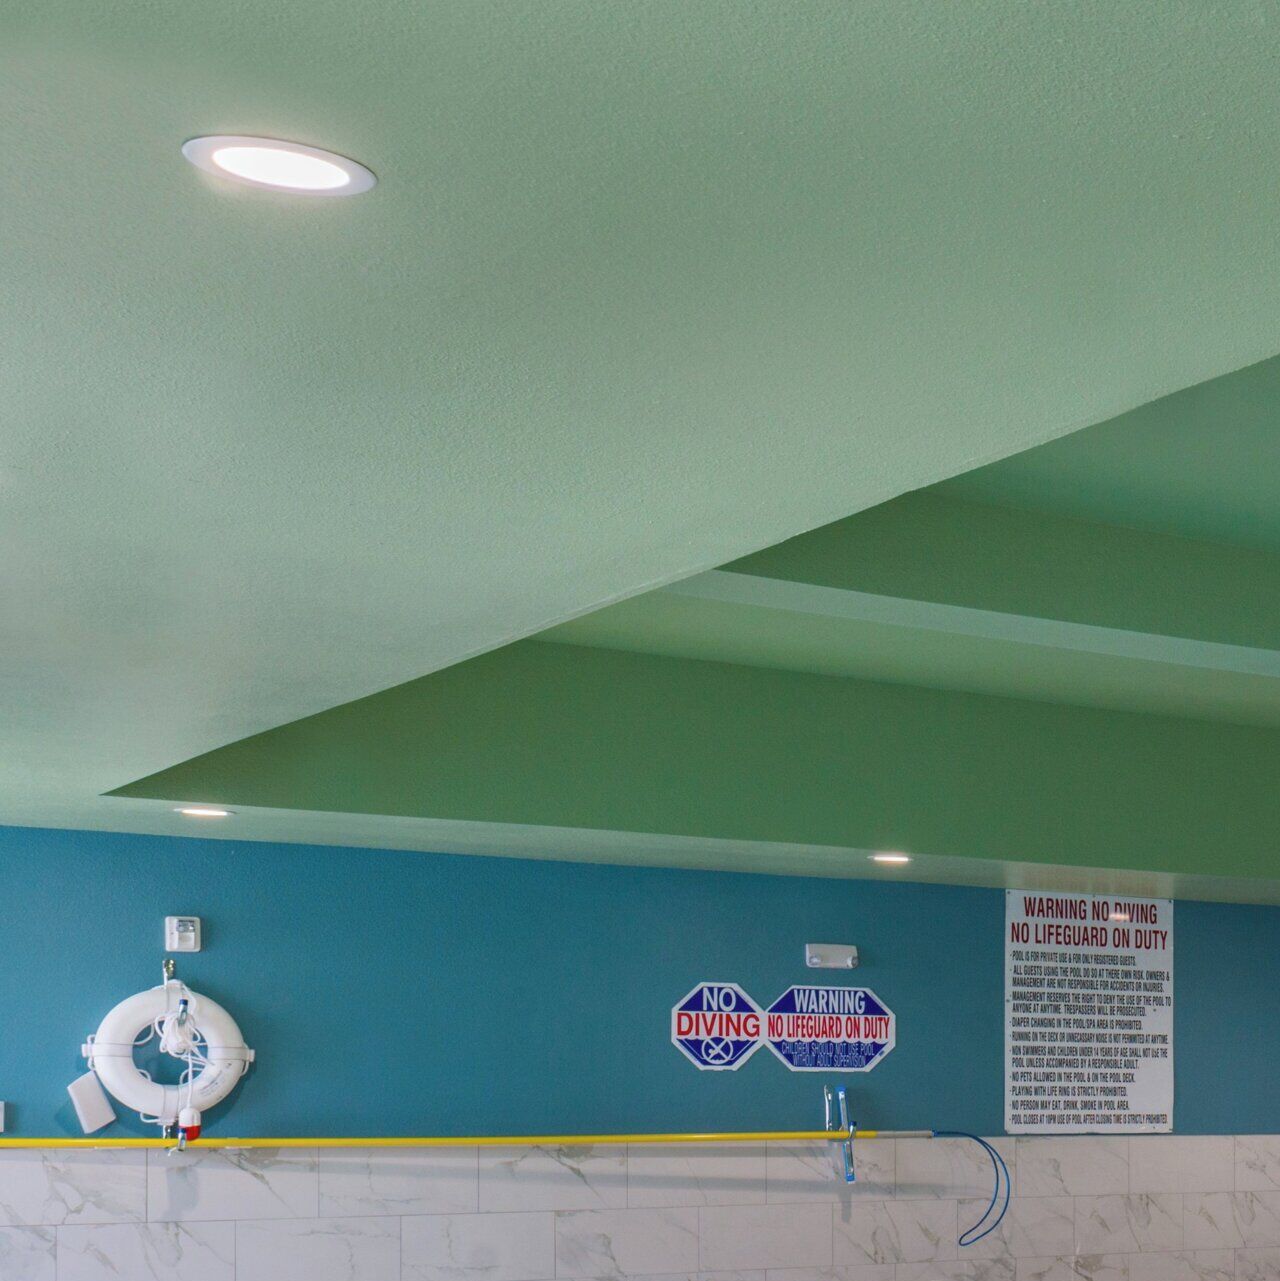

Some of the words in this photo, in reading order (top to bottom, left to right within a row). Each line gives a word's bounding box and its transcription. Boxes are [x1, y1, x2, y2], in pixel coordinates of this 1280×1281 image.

[1024, 896, 1087, 920] WARNING
[1092, 901, 1109, 921] NO
[1114, 902, 1157, 924] DIVING
[1011, 922, 1029, 943] NO
[1035, 923, 1108, 947] LIFEGUARD
[1113, 928, 1129, 948] ON
[1135, 929, 1167, 950] DUTY
[1012, 950, 1024, 961] POOL
[1025, 951, 1030, 961] IS
[1031, 951, 1039, 962] FOR
[1040, 951, 1058, 962] PRIVATE
[1059, 952, 1068, 963] USE
[1069, 953, 1072, 963] &
[1073, 953, 1082, 964] FOR
[1082, 954, 1093, 964] ONLY
[1120, 956, 1136, 966] GUESTS.
[1013, 965, 1022, 975] ALL
[1023, 965, 1042, 976] GUESTS
[1043, 966, 1058, 977] USING
[1060, 967, 1068, 977] THE
[1070, 967, 1082, 978] POOL
[1083, 968, 1089, 978] DO
[1091, 968, 1097, 978] SO
[1099, 968, 1105, 979] AT
[1106, 969, 1120, 979] THERE
[1121, 969, 1132, 980] OWN
[1133, 970, 1144, 980] RISK.
[1146, 970, 1165, 981] OWNERS
[1166, 971, 1170, 981] &
[1047, 978, 1056, 988] ARE
[1057, 978, 1066, 988] NOT
[1100, 980, 1109, 990] FOR
[1110, 980, 1135, 991] ACCIDENTS
[1136, 981, 1142, 991] OR
[1143, 981, 1164, 992] INJURIES.
[702, 987, 736, 1012] NO
[794, 989, 865, 1014] WARNING
[1047, 992, 1070, 1003] RESERVES
[1072, 993, 1080, 1003] THE
[1082, 993, 1095, 1004] RIGHT
[1097, 994, 1102, 1004] TO
[1103, 994, 1115, 1005] DENY
[1116, 994, 1125, 1005] THE
[1126, 995, 1135, 1005] USE
[1136, 995, 1142, 1005] OF
[1143, 995, 1151, 1006] THE
[1153, 996, 1164, 1006] POOL
[1165, 996, 1171, 1007] TO
[1012, 1003, 1032, 1013] ANYONE
[1033, 1004, 1039, 1014] AT
[1097, 1005, 1108, 1016] WILL
[1110, 1006, 1116, 1016] BE
[676, 1012, 760, 1037] DIVING
[768, 1015, 783, 1037] NO
[787, 1015, 842, 1039] LIFEGUARD
[846, 1016, 861, 1039] ON
[864, 1017, 890, 1039] DUTY
[1012, 1017, 1030, 1027] DIAPER
[1031, 1017, 1055, 1028] CHANGING
[1056, 1018, 1061, 1028] IN
[1063, 1018, 1072, 1028] THE
[1097, 1019, 1108, 1029] AREA
[1110, 1019, 1114, 1029] IS
[1012, 1031, 1031, 1042] RUNNING
[1032, 1031, 1038, 1042] ON
[1039, 1032, 1047, 1042] THE
[1048, 1032, 1059, 1042] DECK
[1060, 1032, 1065, 1042] OR
[1096, 1033, 1107, 1043] NOISE
[1108, 1033, 1112, 1043] IS
[1113, 1033, 1121, 1043] NOT
[1145, 1034, 1151, 1044] AT
[782, 1042, 810, 1054] CHILDREN
[811, 1042, 834, 1056] SHOULD
[835, 1043, 847, 1055] NOT
[848, 1043, 859, 1055] USE
[860, 1043, 875, 1056] POOL
[1012, 1045, 1021, 1056] NON
[1022, 1045, 1047, 1056] SWIMMERS
[1048, 1046, 1056, 1056] AND
[1057, 1046, 1078, 1056] CHILDREN
[1079, 1046, 1093, 1056] UNDER
[1094, 1047, 1099, 1057] 14
[1100, 1047, 1113, 1057] YEARS
[1114, 1047, 1119, 1057] OF
[1120, 1047, 1128, 1057] AGE
[1129, 1047, 1141, 1057] SHALL
[1143, 1048, 1151, 1057] NOT
[1151, 1048, 1159, 1057] USE
[1160, 1048, 1168, 1057] THE
[793, 1054, 816, 1066] WITHOUT
[817, 1054, 833, 1067] ADULT
[834, 1055, 866, 1067] SUPERVISION
[1012, 1057, 1024, 1068] POOL
[1026, 1057, 1046, 1068] UNLESS
[1124, 1059, 1139, 1069] ADULT.
[1020, 1072, 1032, 1082] PETS
[1033, 1072, 1056, 1082] ALLOWED
[1063, 1072, 1072, 1082] THE
[1073, 1072, 1086, 1083] POOL
[1100, 1072, 1108, 1083] THE
[1109, 1072, 1121, 1083] POOL
[1122, 1073, 1136, 1083] DECK.
[1012, 1086, 1032, 1096] PLAYING
[1034, 1086, 1046, 1096] WITH
[1047, 1086, 1057, 1096] LIFE
[1058, 1086, 1070, 1096] RING
[1077, 1086, 1099, 1097] STRICTLY
[1020, 1100, 1039, 1110] PERSON
[1040, 1100, 1051, 1110] MAY
[1080, 1100, 1096, 1110] SMOKE
[1104, 1100, 1116, 1110] POOL
[1116, 1100, 1130, 1110] AREA.
[1012, 1114, 1022, 1124] POOL
[1023, 1114, 1039, 1124] CLOSES
[1057, 1114, 1065, 1124] USE
[1072, 1114, 1082, 1124] POOL
[1083, 1114, 1095, 1124] AFTER
[1096, 1114, 1112, 1124] CLOSING
[1113, 1114, 1122, 1124] TIME
[1127, 1114, 1146, 1124] STRICTLY
